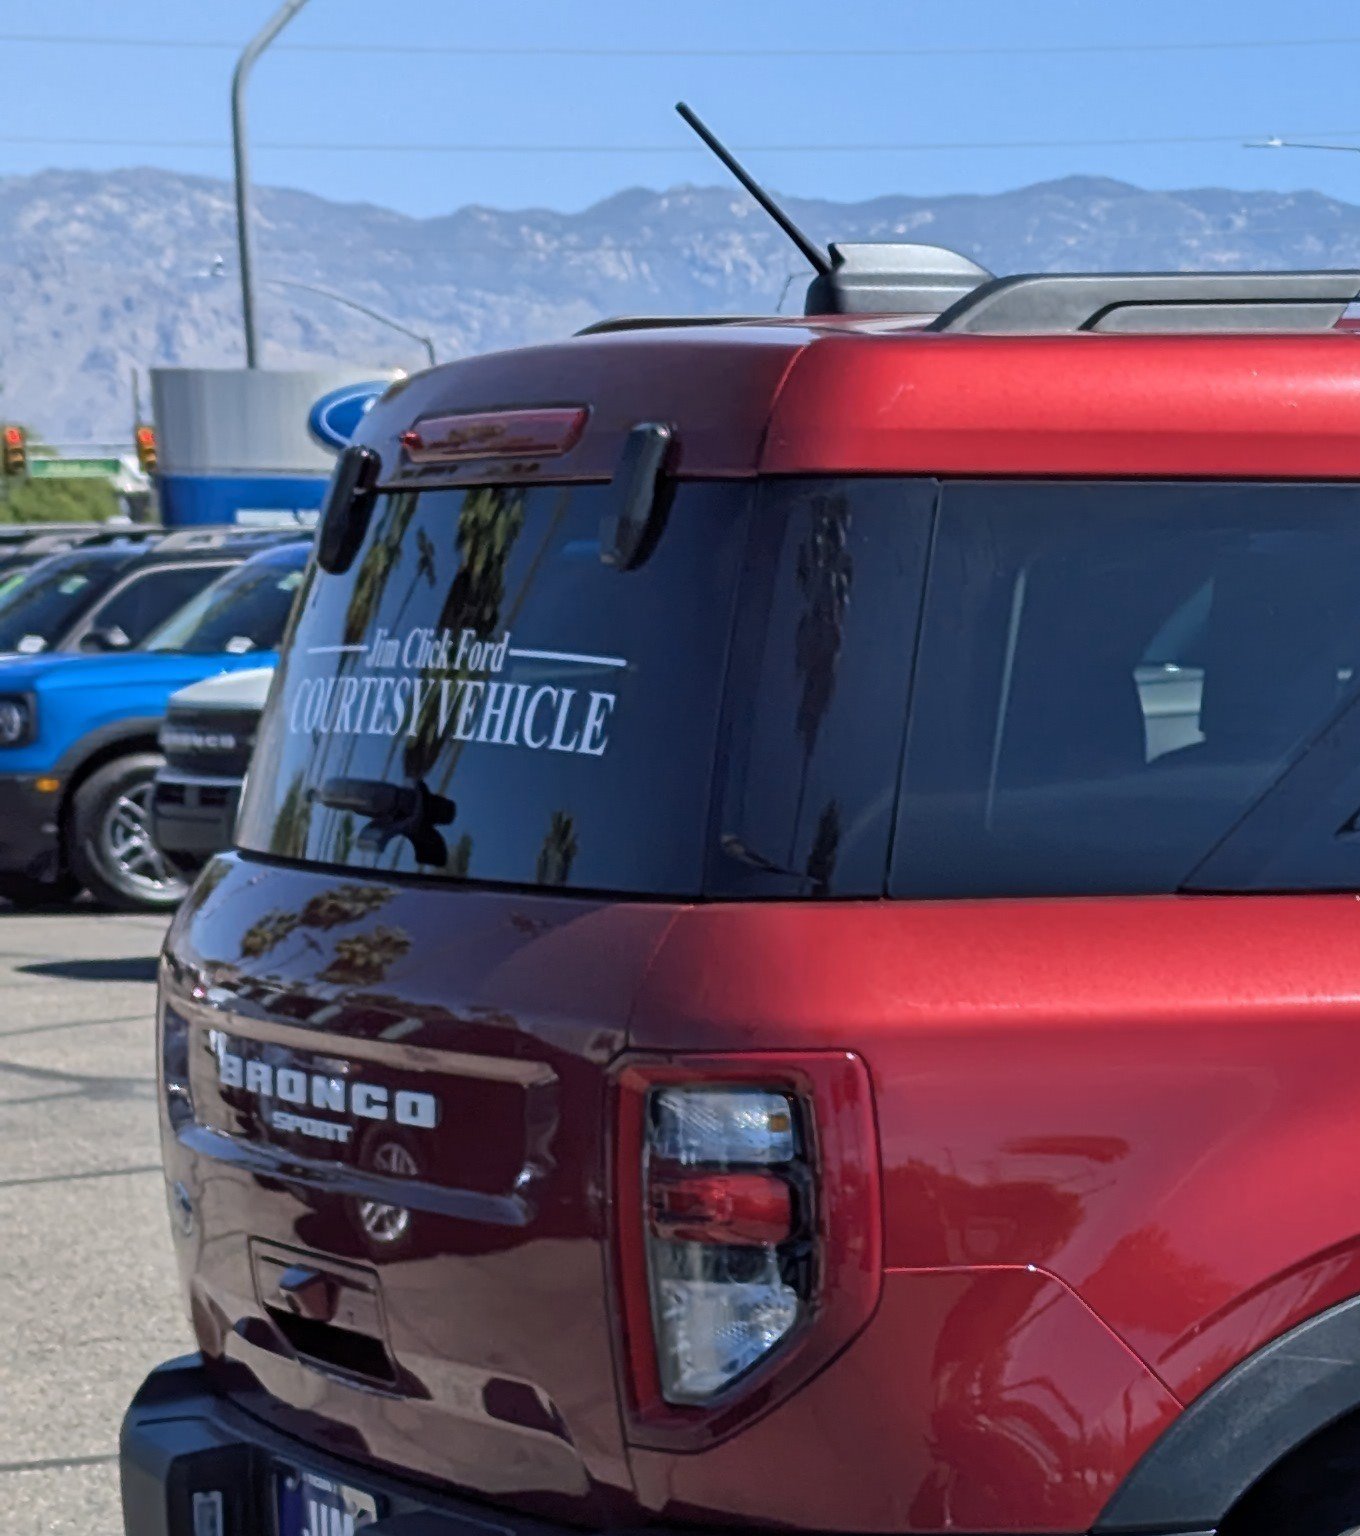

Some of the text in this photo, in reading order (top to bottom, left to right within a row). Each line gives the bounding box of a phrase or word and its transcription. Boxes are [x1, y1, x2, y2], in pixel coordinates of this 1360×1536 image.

[366, 627, 510, 672] Jim Click Ford
[290, 676, 615, 756] COURTESY VEHICLE
[220, 1053, 437, 1129] BRONCO
[272, 1110, 353, 1143] SPORT
